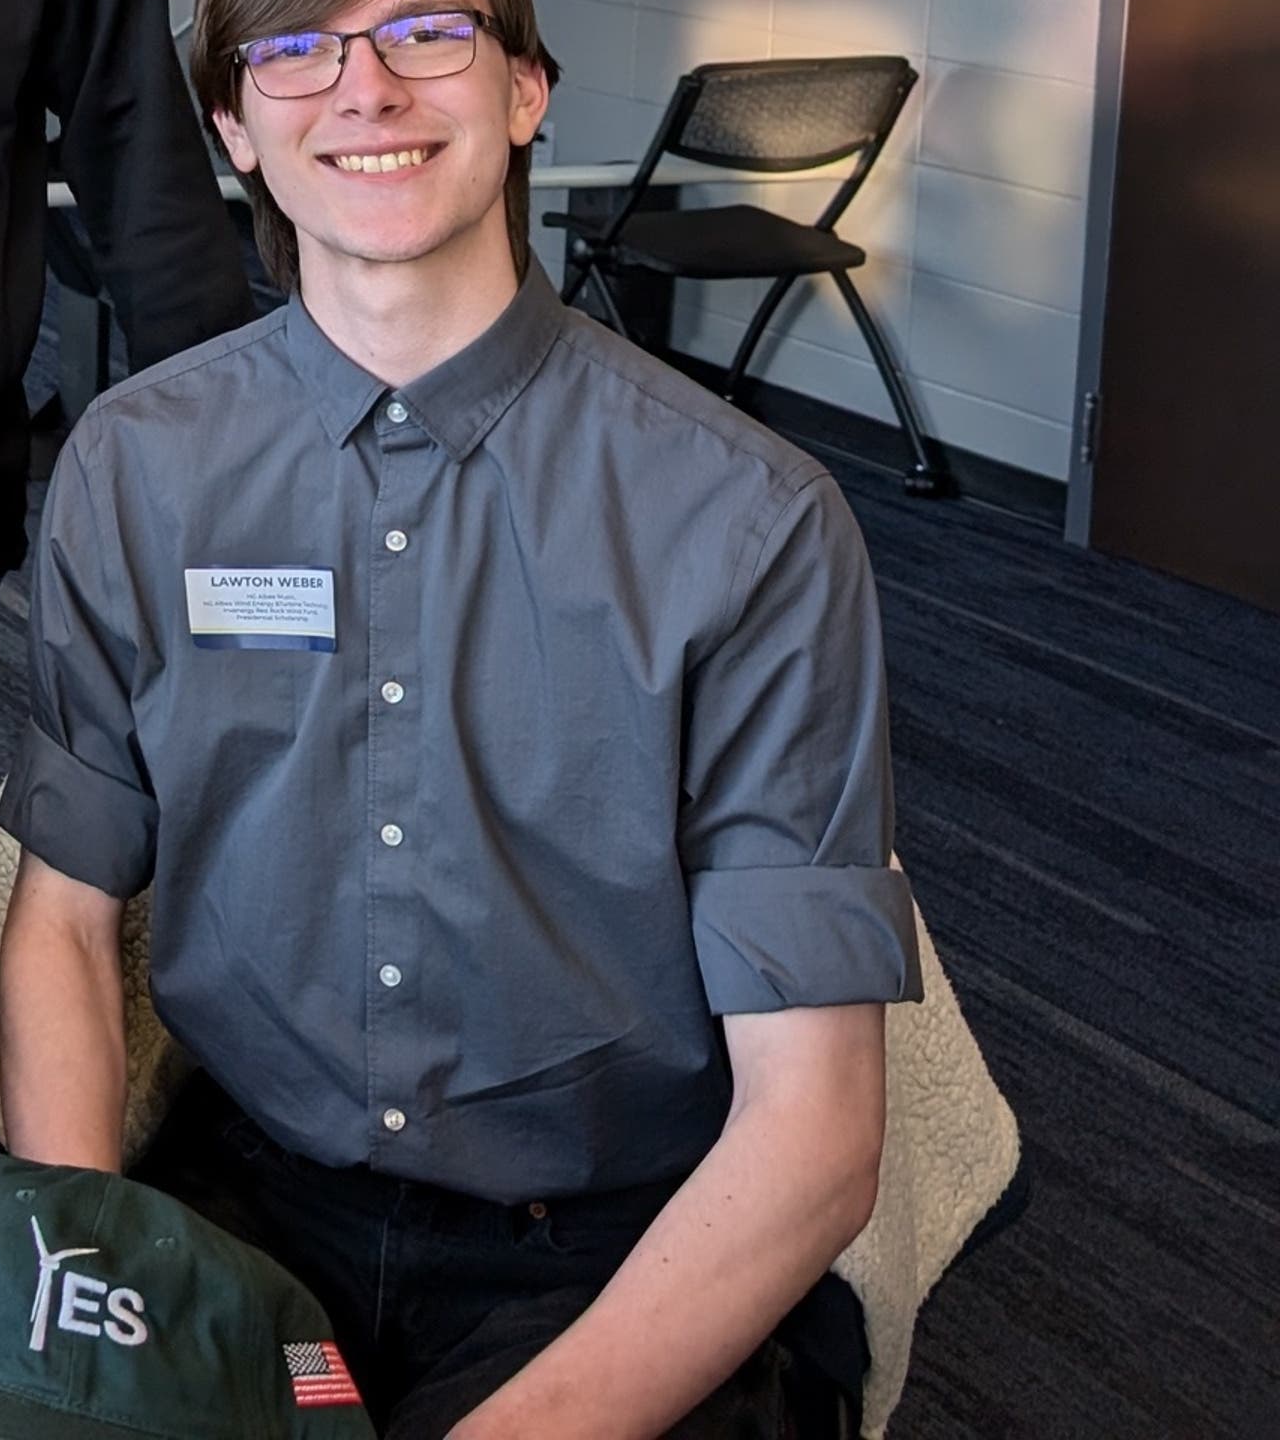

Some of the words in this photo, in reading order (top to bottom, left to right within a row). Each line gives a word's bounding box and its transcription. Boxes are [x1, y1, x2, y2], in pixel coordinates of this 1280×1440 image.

[211, 576, 274, 588] LAWTON
[277, 576, 324, 589] WEBER
[28, 1214, 149, 1352] YES
